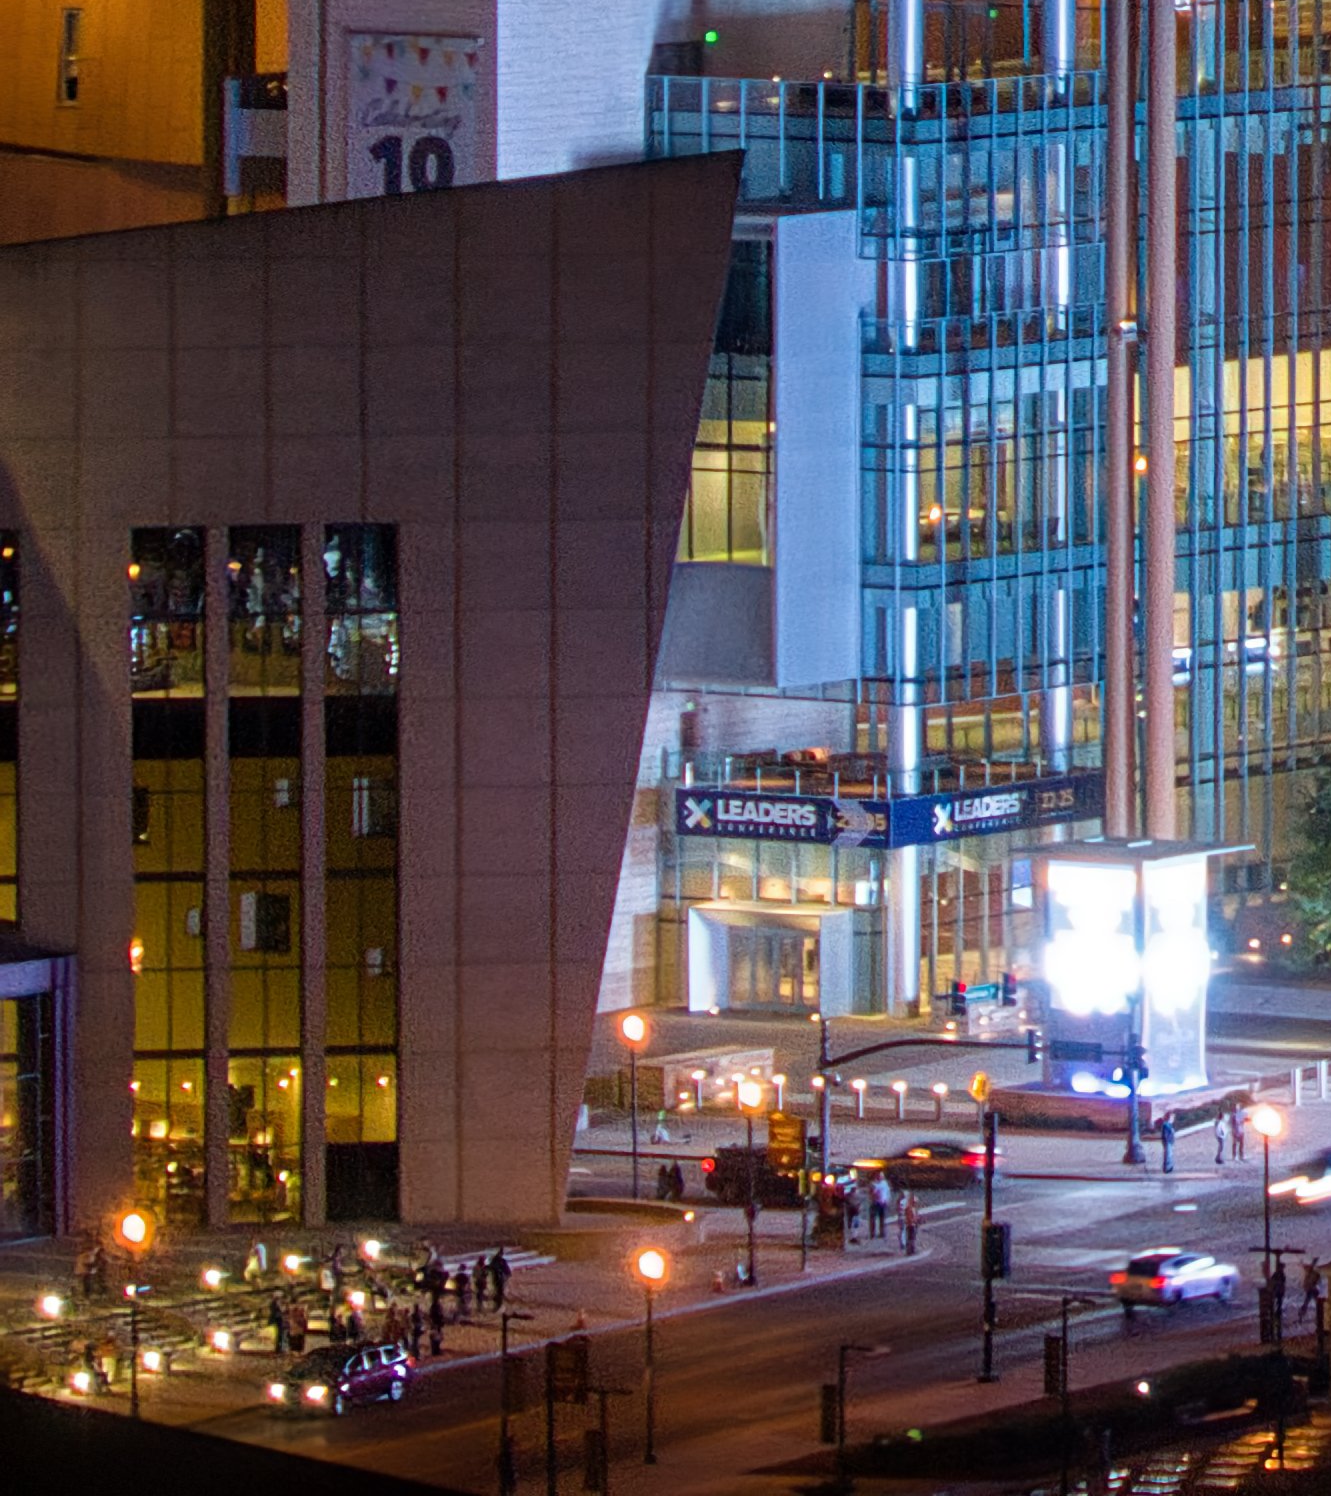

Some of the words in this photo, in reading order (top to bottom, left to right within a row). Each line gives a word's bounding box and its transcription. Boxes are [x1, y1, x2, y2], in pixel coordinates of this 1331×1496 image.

[369, 136, 454, 196] 10
[717, 799, 817, 827] LEADERS
[954, 793, 1020, 822] LEADERS
